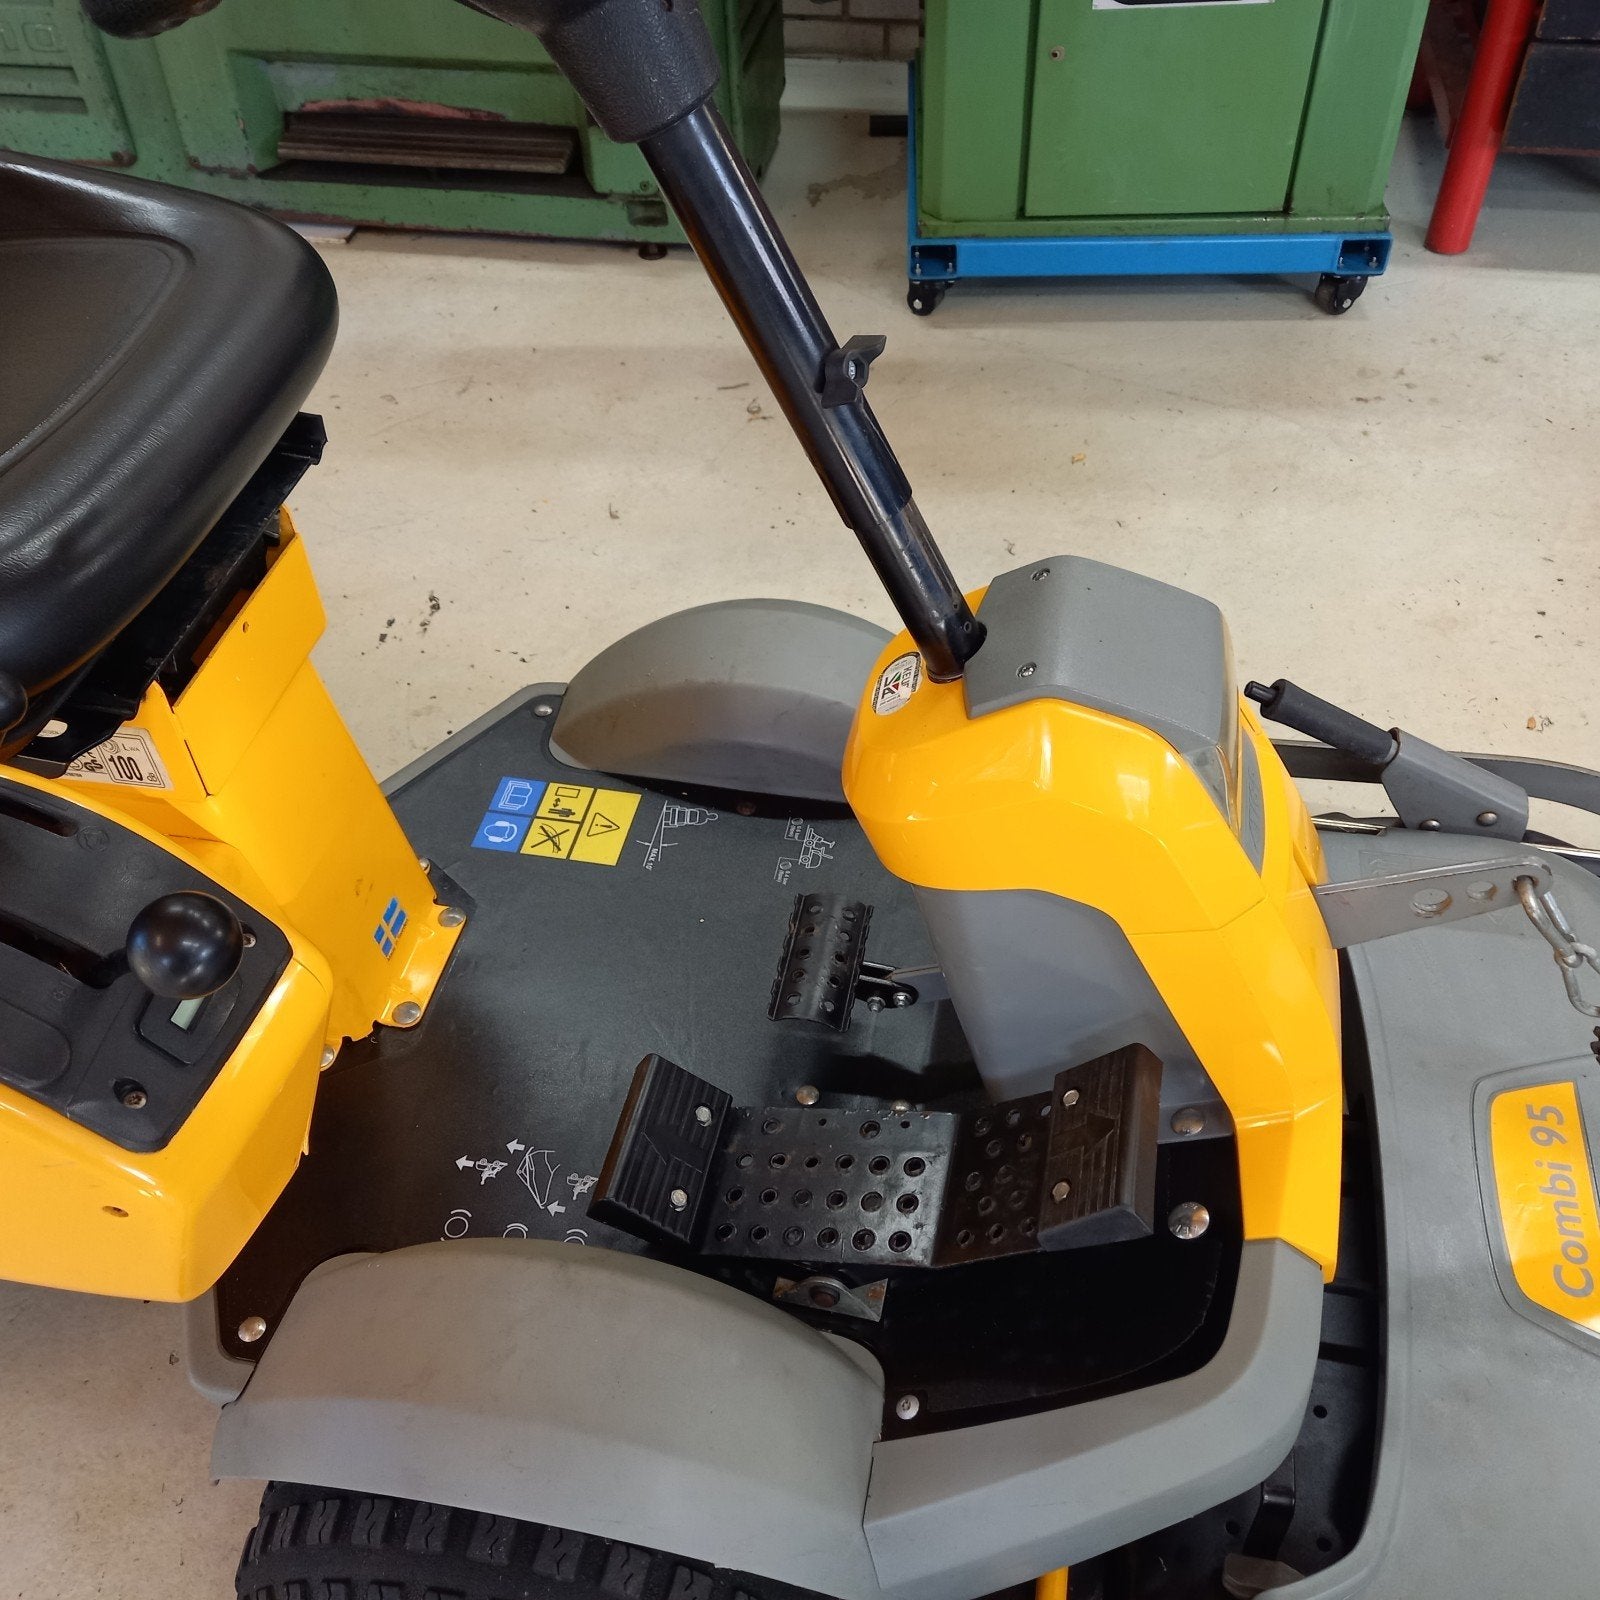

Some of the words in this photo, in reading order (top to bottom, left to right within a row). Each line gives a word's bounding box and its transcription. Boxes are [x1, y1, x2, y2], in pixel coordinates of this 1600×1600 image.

[108, 755, 144, 781] 100
[648, 847, 659, 861] MAX
[1526, 1103, 1567, 1147] 95
[1534, 1159, 1594, 1298] Combi
